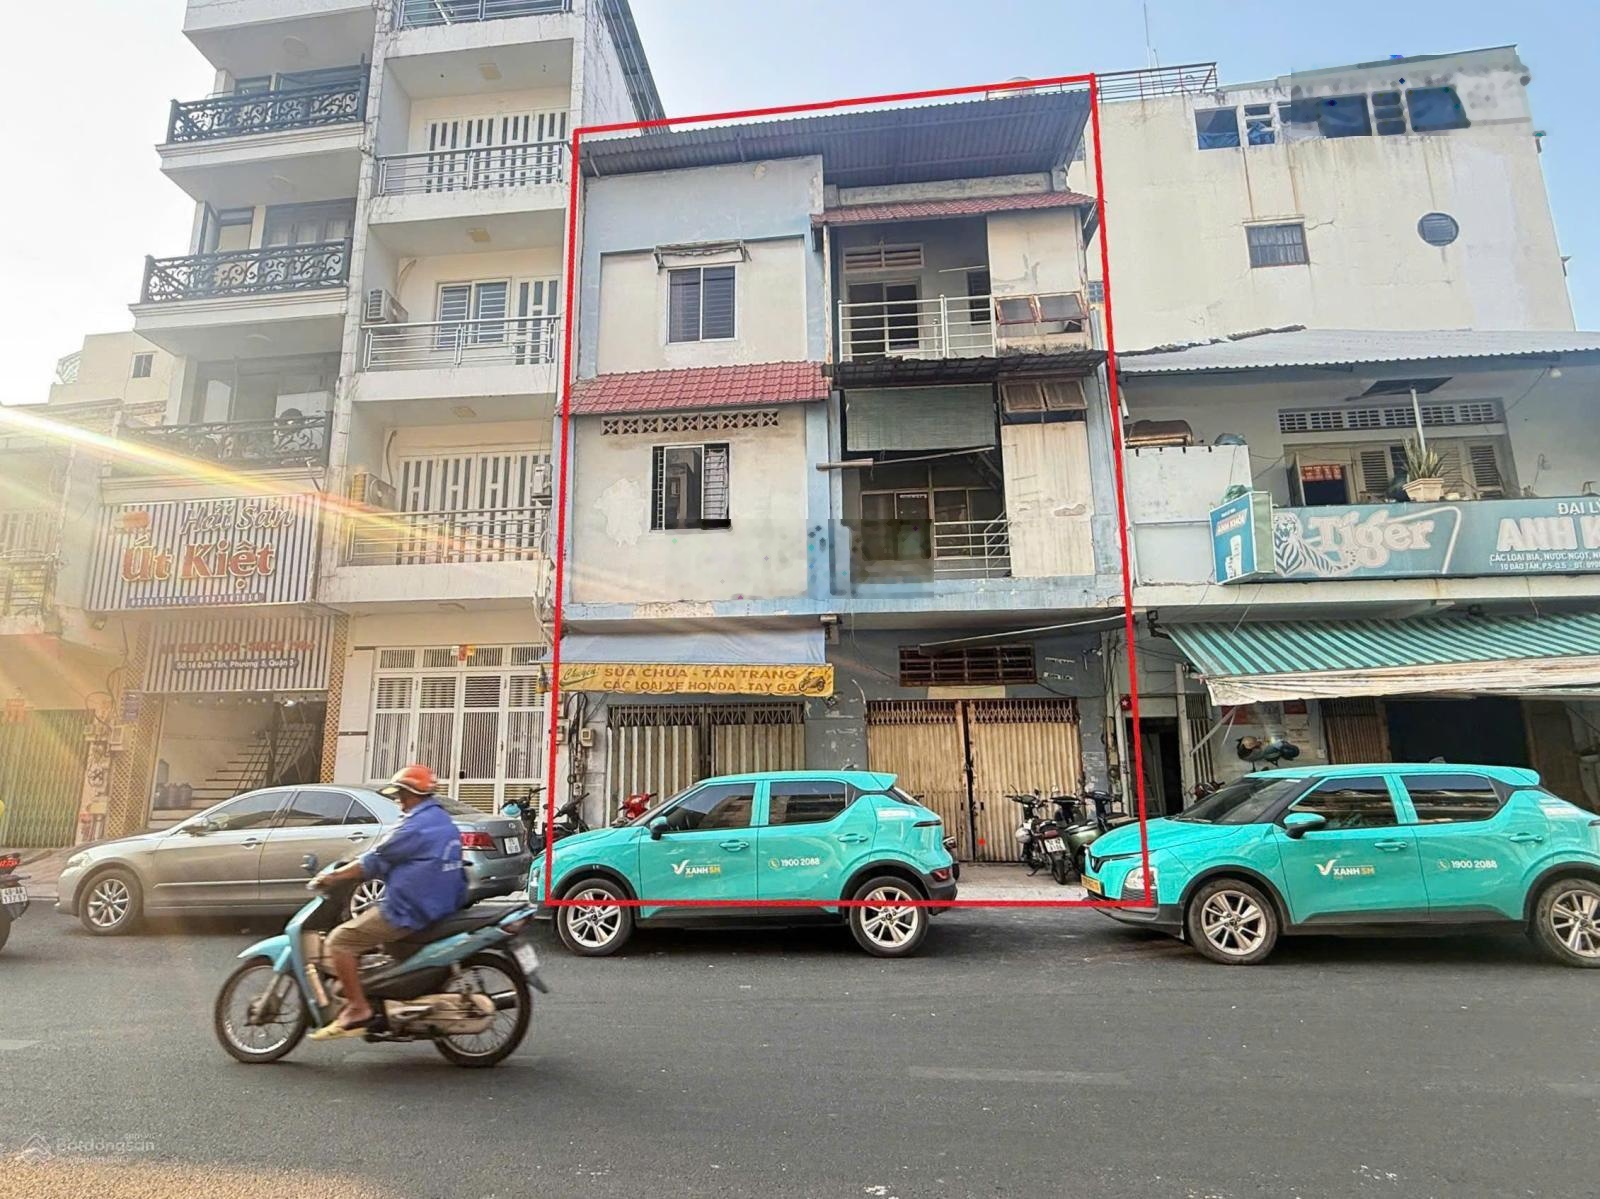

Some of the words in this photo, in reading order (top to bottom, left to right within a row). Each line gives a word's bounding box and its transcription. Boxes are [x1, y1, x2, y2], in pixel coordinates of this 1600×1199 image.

[1558, 502, 1585, 515] ĐẠI
[180, 503, 234, 535] Hải
[235, 501, 295, 530] Sản
[1310, 511, 1435, 567] Tiger
[1496, 517, 1578, 551] ANH
[121, 534, 173, 582] Út
[180, 539, 276, 589] Kiệt
[740, 669, 798, 680] TRANG
[603, 679, 631, 690] CÁC
[665, 681, 684, 691] XE
[687, 681, 736, 691] HONDA
[747, 683, 772, 692] TAY
[776, 683, 796, 692] GA
[781, 859, 799, 867] 1900
[1451, 860, 1473, 869] 1900
[1333, 867, 1360, 876] XANH
